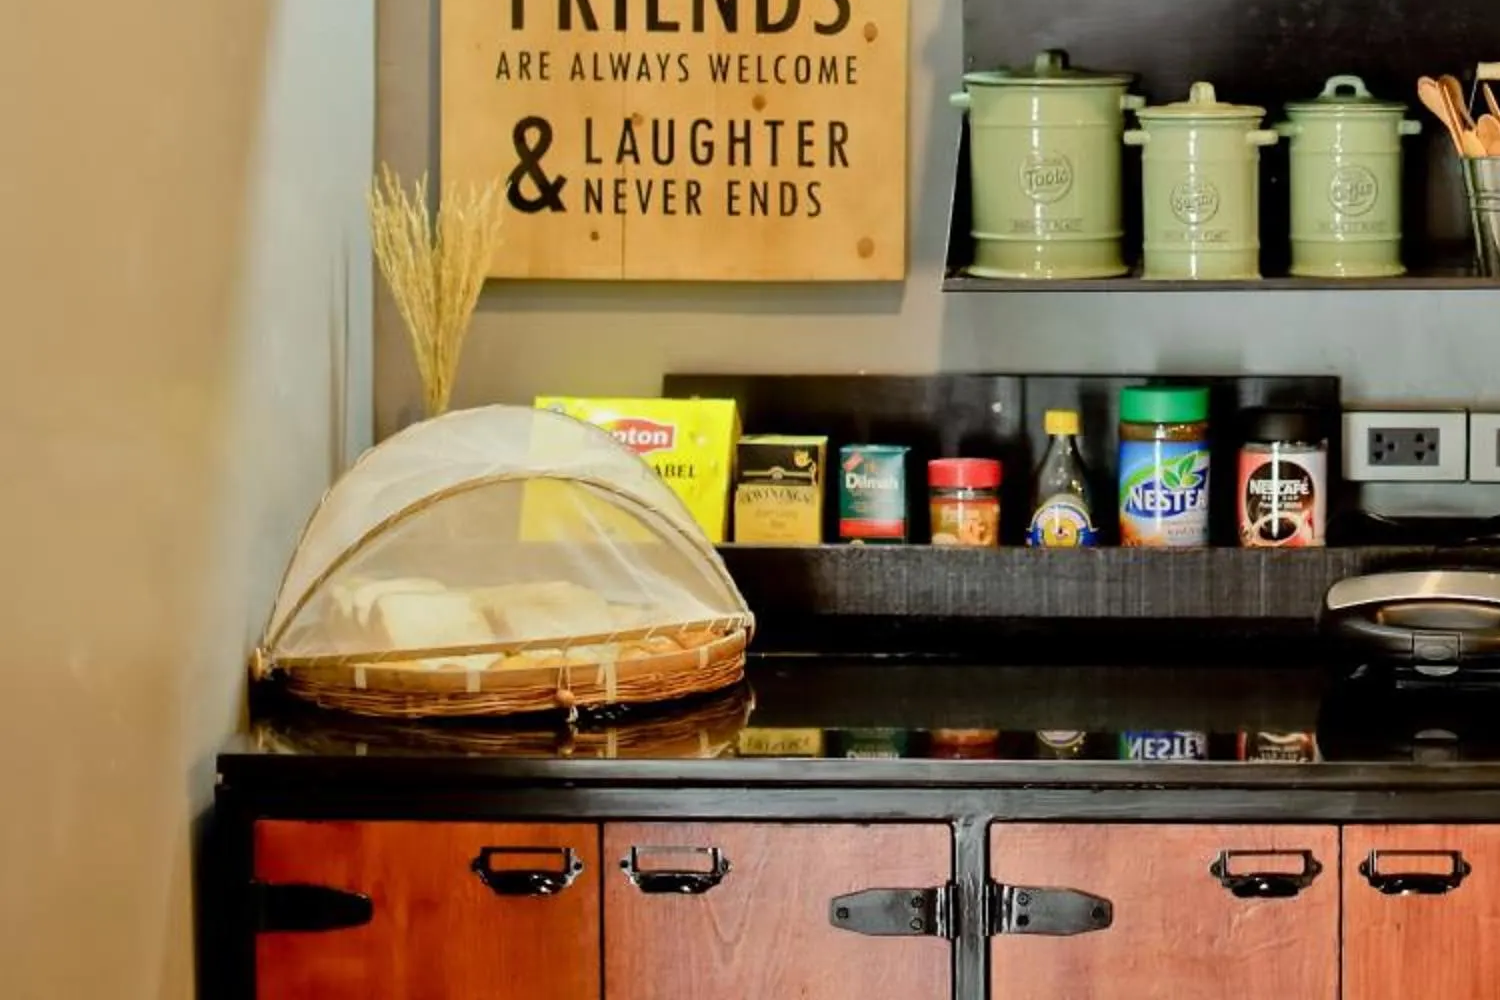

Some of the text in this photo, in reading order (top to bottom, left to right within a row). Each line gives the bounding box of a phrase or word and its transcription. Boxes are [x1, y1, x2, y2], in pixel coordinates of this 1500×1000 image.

[496, 52, 856, 84] ARE ALWAYS WELCOME
[506, 116, 848, 214] & LAUGHTER
[585, 178, 820, 217] NEVER ENDS
[648, 464, 696, 479] ABEL
